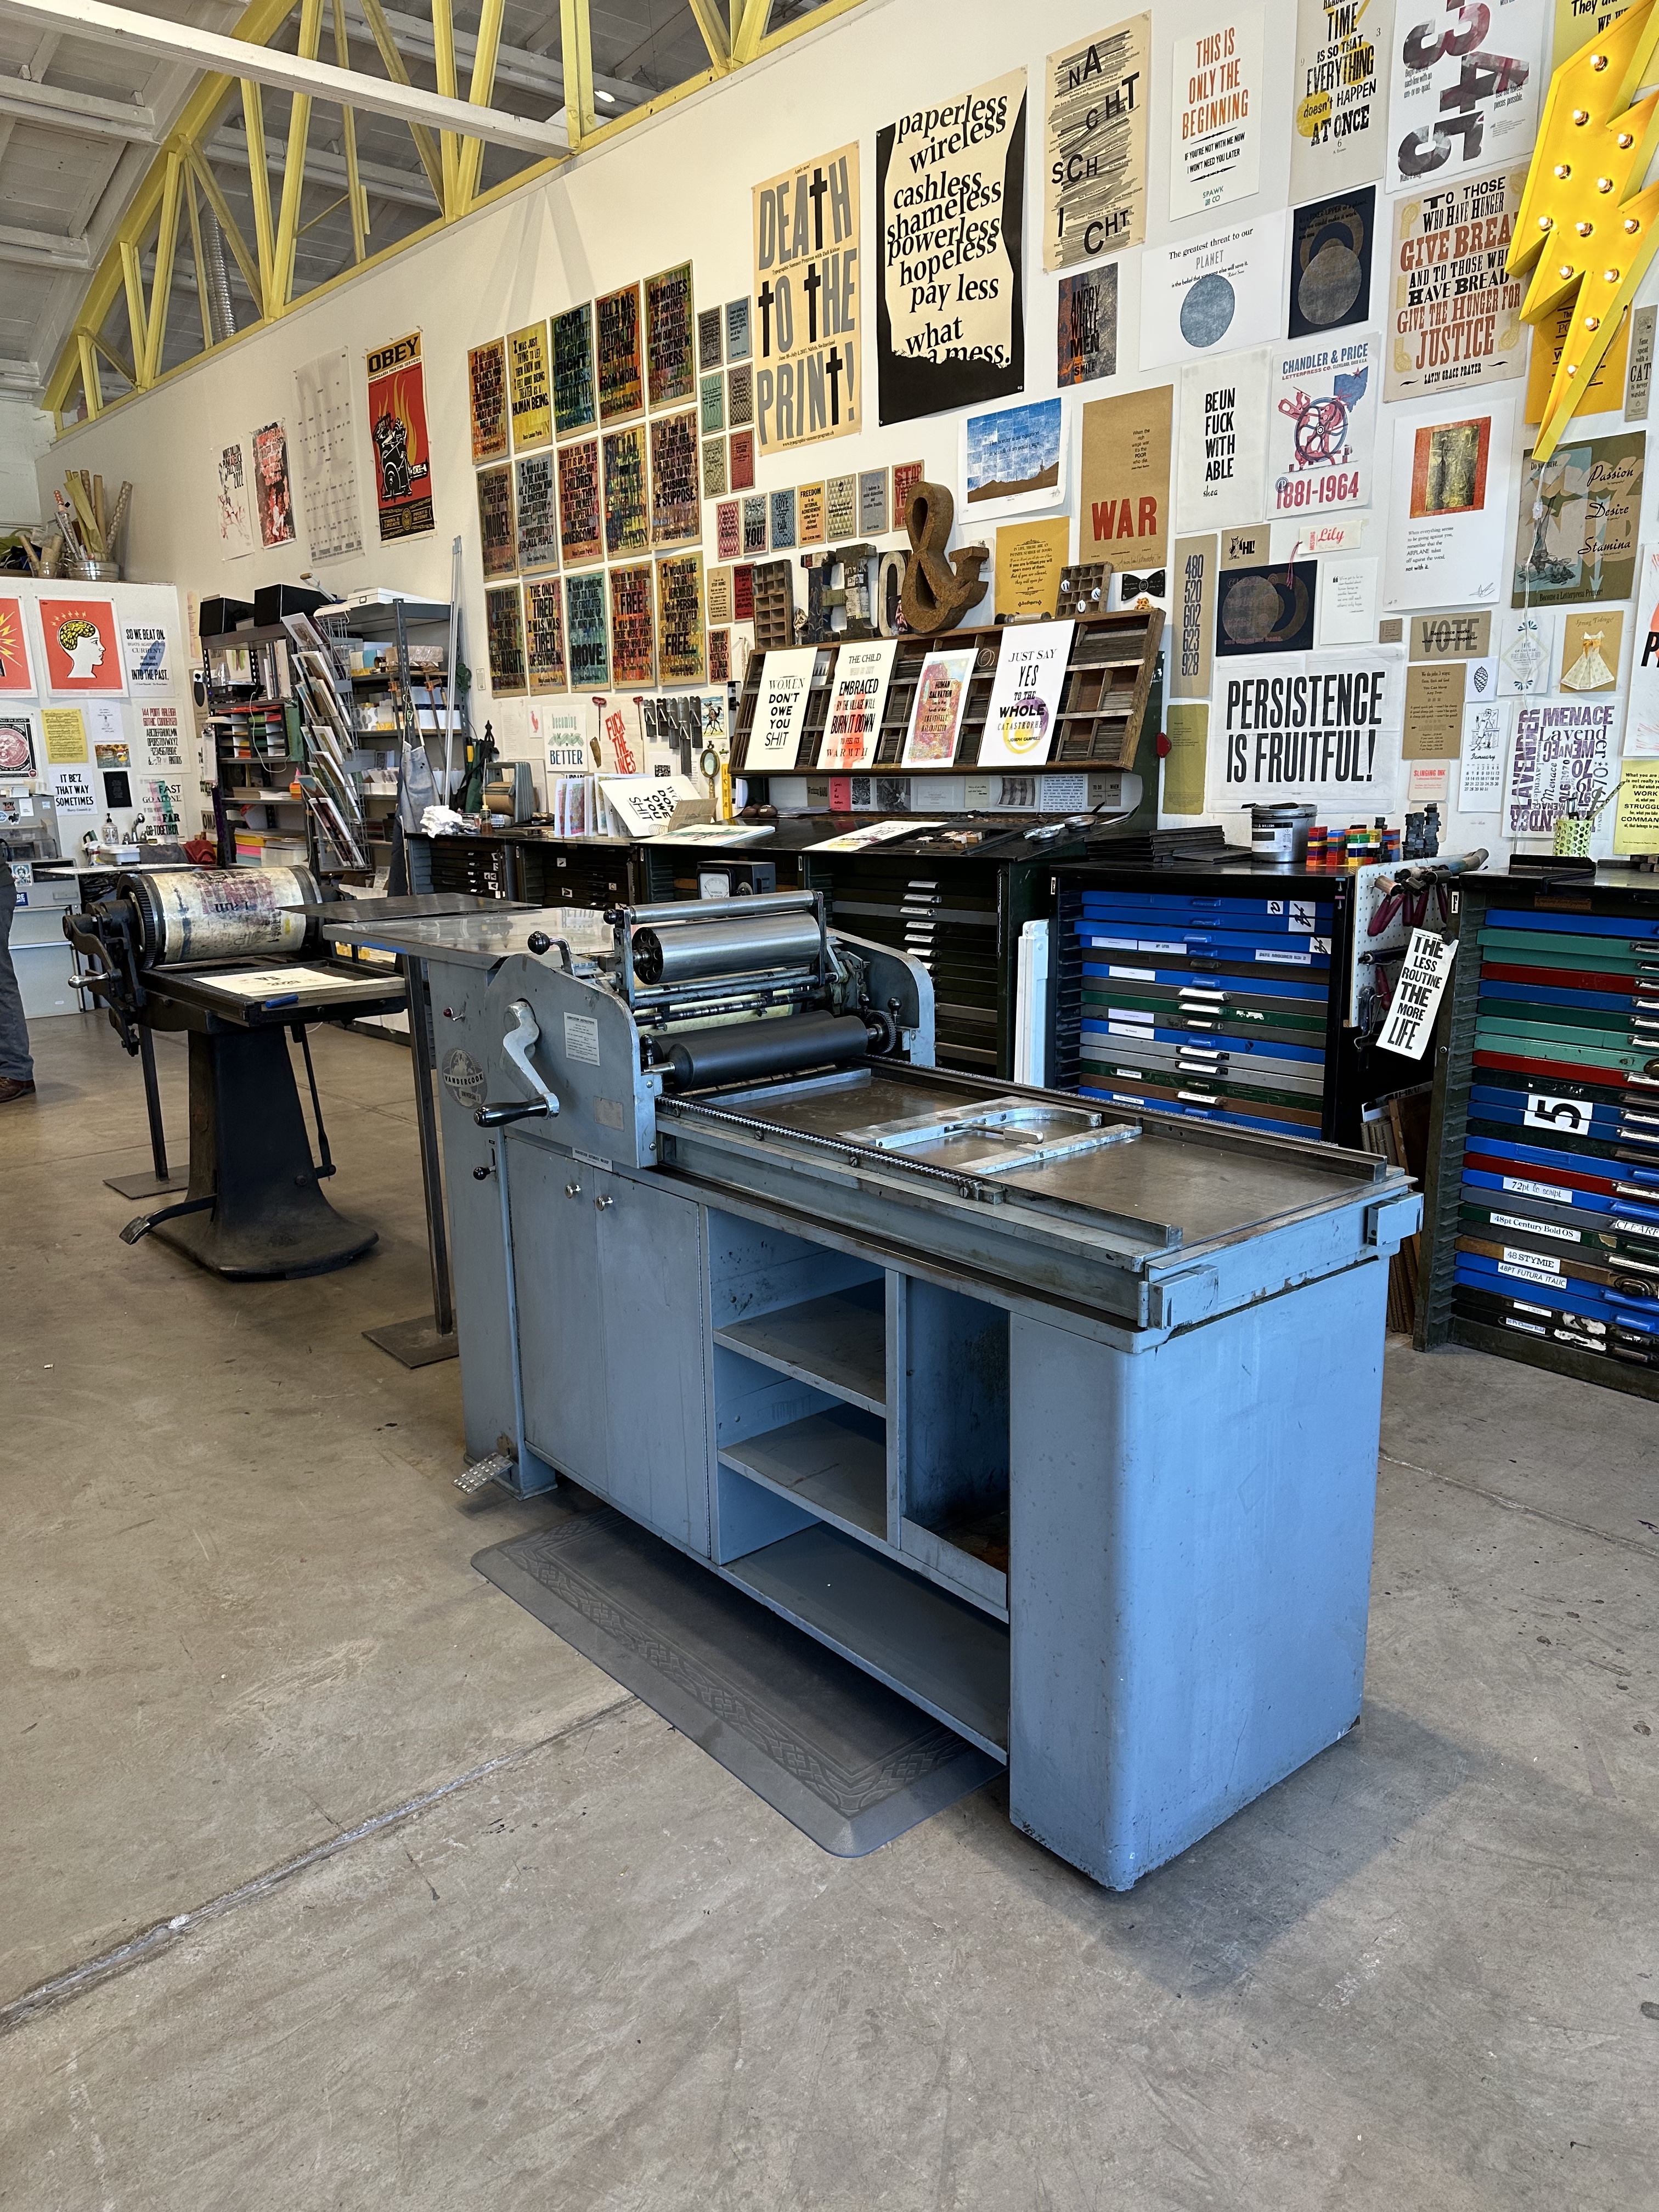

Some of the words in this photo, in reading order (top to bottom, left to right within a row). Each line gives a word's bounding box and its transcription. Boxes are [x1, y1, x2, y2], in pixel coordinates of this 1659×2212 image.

[1571, 0, 1598, 16] They
[1327, 2, 1358, 42] TIME
[1197, 33, 1221, 69] THIS
[1224, 27, 1234, 58] IS
[1317, 50, 1325, 63] IS
[1327, 44, 1339, 59] SO
[1341, 34, 1363, 54] THAT
[1189, 68, 1216, 104] ONLY
[1220, 58, 1240, 93] THE
[1306, 45, 1374, 98] EVERYTHING
[1304, 95, 1333, 118] doesn't
[1336, 78, 1376, 107] HAPPEN
[897, 94, 1007, 144] paperless
[1182, 89, 1249, 140] BEGINNING
[1311, 117, 1331, 146] AT
[1334, 104, 1370, 138] ONCE
[909, 111, 1006, 173] wireless
[1189, 146, 1204, 159] YOU'RE
[1205, 143, 1214, 154] NOT
[1215, 138, 1226, 150] WITH
[1234, 132, 1245, 143] NOW
[1189, 161, 1204, 173] WON'T
[1204, 157, 1215, 168] NEED
[1216, 153, 1226, 162] YOU
[1226, 148, 1240, 160] LATER
[894, 171, 981, 209] cashless
[1203, 185, 1224, 198] SPAWK
[1212, 195, 1220, 203] CO
[1424, 191, 1454, 210] TO
[1463, 176, 1506, 199] THOSE
[759, 155, 852, 270] DEATH
[887, 181, 1001, 244] shameless
[1423, 208, 1444, 233] WHO
[1446, 201, 1469, 227] HAVE
[1471, 191, 1504, 219] HUNGER
[887, 217, 1000, 267] powerless
[1169, 251, 1181, 259] The
[1183, 242, 1209, 257] greatest
[1210, 235, 1231, 247] threat
[1241, 228, 1254, 238] our
[1400, 229, 1450, 272] GIVE
[1453, 211, 1520, 259] BREA
[900, 233, 997, 287] hopeless
[1196, 250, 1223, 269] PLANET
[1409, 269, 1429, 289] AND
[1433, 264, 1447, 283] TO
[1450, 255, 1483, 278] THOSE
[650, 279, 687, 306] MEMORIES
[909, 284, 951, 313] pay
[956, 273, 998, 301] less
[1408, 281, 1451, 307] HAVE
[1454, 268, 1510, 296] BREAD
[758, 275, 793, 358] TO
[804, 247, 857, 343] THE
[1071, 285, 1101, 317] ANGRY
[1397, 306, 1425, 334] GIVE
[1430, 300, 1448, 327] THE
[1451, 287, 1499, 322] HUNGER
[1502, 283, 1521, 310] FOR
[905, 317, 964, 355] what
[1071, 309, 1099, 340] WHITE
[1070, 333, 1099, 358] MEN
[1415, 314, 1496, 369] JUSTICE
[369, 336, 419, 373] OBEY
[1283, 352, 1328, 374] CHANDLER
[1330, 349, 1339, 364] &
[1341, 343, 1368, 361] PRICE
[1282, 368, 1322, 380] LETTERPRESS
[1424, 371, 1440, 384] LATIN
[1442, 367, 1458, 381] GRACE
[1460, 363, 1481, 377] PRAYER
[1630, 363, 1651, 382] CAT
[757, 341, 855, 445] PRINT!
[1205, 387, 1235, 413] BEUN
[512, 397, 531, 416] HUMAN
[1205, 411, 1234, 436] FUCK
[1205, 458, 1234, 482] ABLE
[1587, 465, 1634, 487] Passion
[564, 473, 593, 492] CHILDREN
[800, 487, 821, 498] FREEDOM
[1277, 471, 1359, 509] 1881-1964
[1092, 496, 1157, 541] WAR
[1585, 501, 1629, 520] Desire
[746, 526, 765, 547] YOU!
[1318, 527, 1344, 544] Lily
[1577, 536, 1631, 555] Stamina
[1185, 554, 1204, 579] 480
[529, 585, 540, 598] THE
[541, 583, 555, 596] ONLY
[620, 591, 643, 614] FREE
[1184, 579, 1201, 603] 520
[532, 597, 554, 619] TIRED
[1183, 603, 1200, 628] 602
[534, 632, 555, 652] TIRED
[1183, 628, 1200, 652] 623
[1422, 618, 1480, 652] VOTE
[849, 655, 860, 664] THE
[862, 653, 881, 662] CHILD
[1008, 651, 1034, 662] JUST
[1036, 648, 1057, 659] SAY
[1182, 652, 1199, 676] 928
[769, 678, 805, 690] WOMEN
[839, 679, 879, 696] EMBRACED
[1018, 665, 1039, 687] YES
[769, 693, 800, 703] DON'T
[1014, 692, 1022, 701] TO
[1023, 691, 1036, 699] THE
[1226, 672, 1385, 730] PERSISTENCE
[552, 713, 577, 730] becoming
[771, 706, 793, 716] OWE
[1000, 704, 1046, 718] WHOLE
[1542, 706, 1615, 726] MENACE
[605, 709, 625, 740] FUCK
[770, 719, 790, 729] YOU
[831, 715, 848, 734] BURN
[847, 714, 856, 733] IT
[855, 713, 876, 732] DOWN
[997, 720, 1043, 730] CATASTROPHE
[612, 732, 629, 758] THE
[765, 732, 789, 746] SHIT
[550, 749, 583, 765] BETTER
[614, 751, 636, 774] LIKES
[827, 748, 868, 757] WARMTH
[1227, 733, 1247, 782] IS
[1255, 729, 1376, 782] FRUITFUL!
[1470, 753, 1496, 761] January
[55, 786, 73, 794] THAT
[74, 785, 89, 794] WAY
[56, 797, 94, 806] SOMETIMES
[159, 785, 180, 794] FAST
[629, 797, 654, 821] SHIT
[1414, 936, 1444, 959] THE
[1413, 955, 1437, 972] LESS
[1402, 967, 1442, 989] ROUTINE
[1400, 981, 1432, 1008] THE
[1397, 1003, 1426, 1021] MORE
[1387, 1017, 1420, 1050] LIFE
[445, 1074, 483, 1085] VANDERCOOK
[1511, 1181, 1529, 1192] 72pt
[1543, 1188, 1561, 1199] script
[1494, 1215, 1511, 1225] 48pt
[1514, 1219, 1543, 1232] Century
[1544, 1225, 1560, 1235] Bold
[1562, 1229, 1573, 1238] OS
[1519, 1254, 1554, 1268] STYMIE
[1500, 1265, 1515, 1273] 48PT
[1517, 1269, 1543, 1281] FUTURA
[1545, 1276, 1566, 1287] ITALIC
